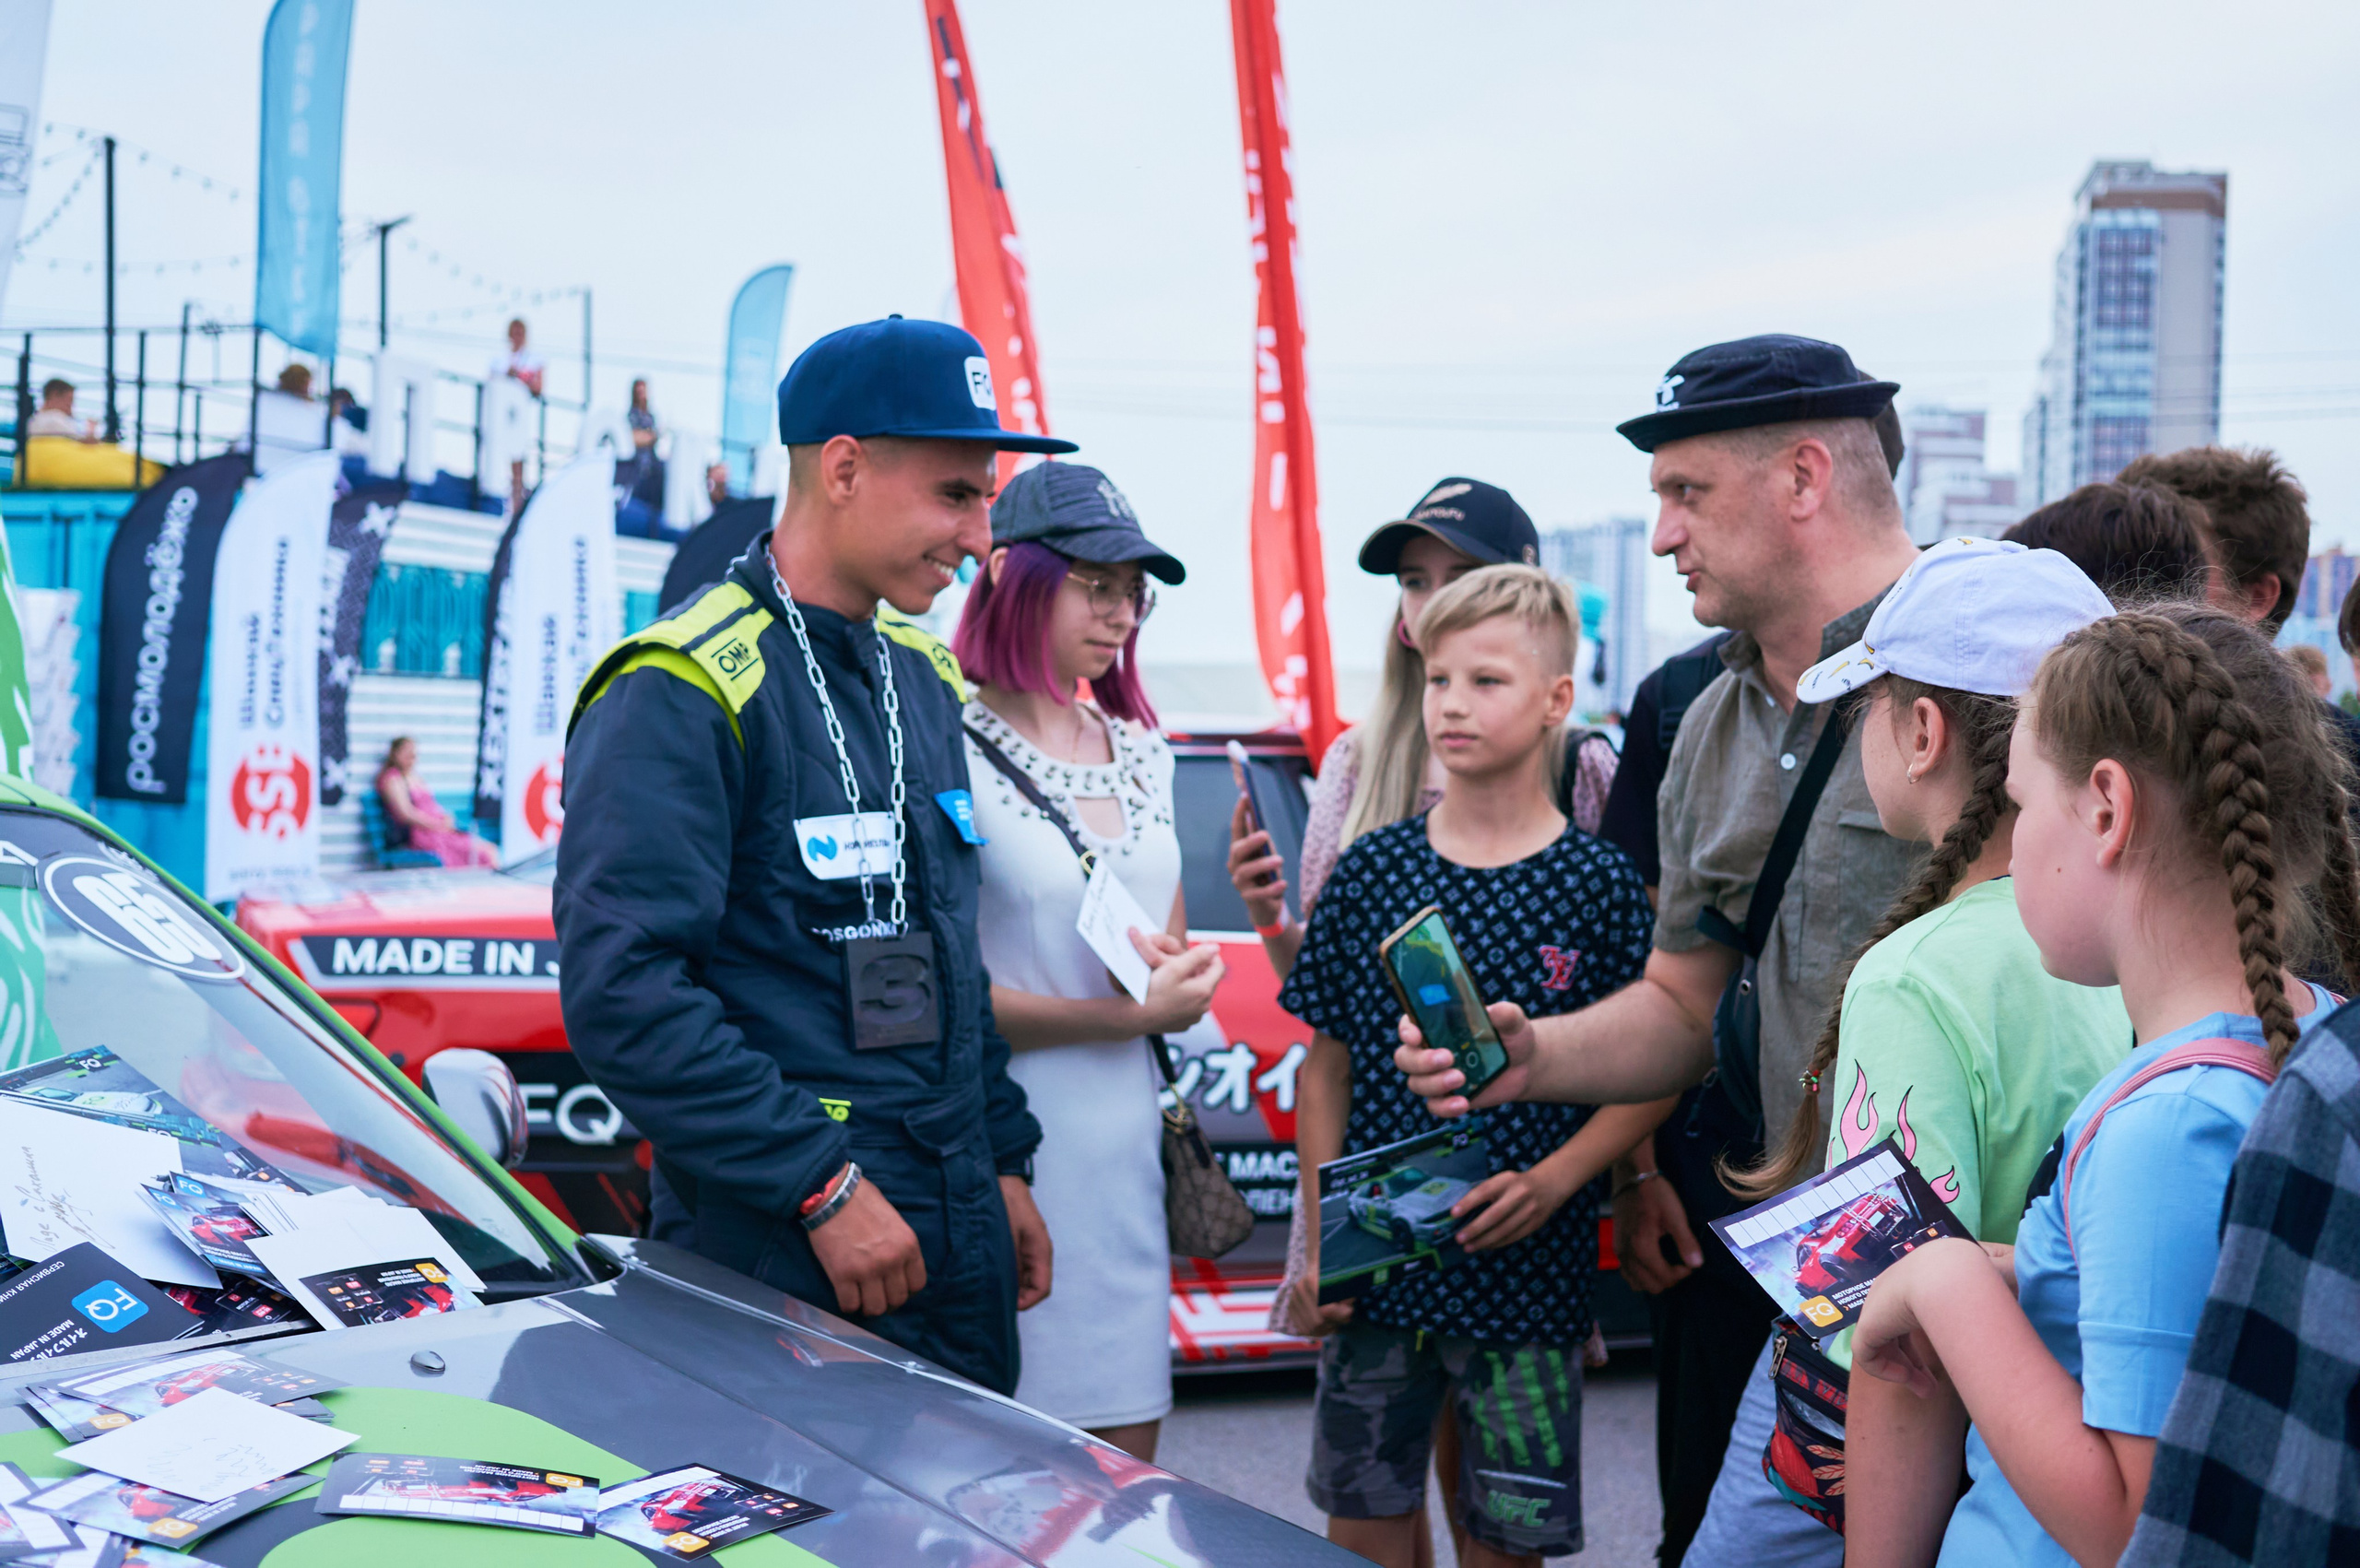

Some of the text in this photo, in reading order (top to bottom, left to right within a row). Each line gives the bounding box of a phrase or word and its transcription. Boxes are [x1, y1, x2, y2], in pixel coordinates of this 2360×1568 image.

[717, 641, 752, 674] OMP
[332, 937, 477, 975] MADE
[484, 940, 536, 975] IN
[858, 952, 932, 1026] 3
[179, 1179, 205, 1196] FQ
[18, 1260, 65, 1291] СЕРВИСНАЯ
[85, 1287, 138, 1321] FQ
[1804, 1302, 1836, 1323] FQ
[10, 1318, 75, 1361] MADE IN JAPAN
[93, 1415, 127, 1428] FQ
[1487, 1489, 1552, 1528] UFC
[672, 1534, 701, 1550] FQ
